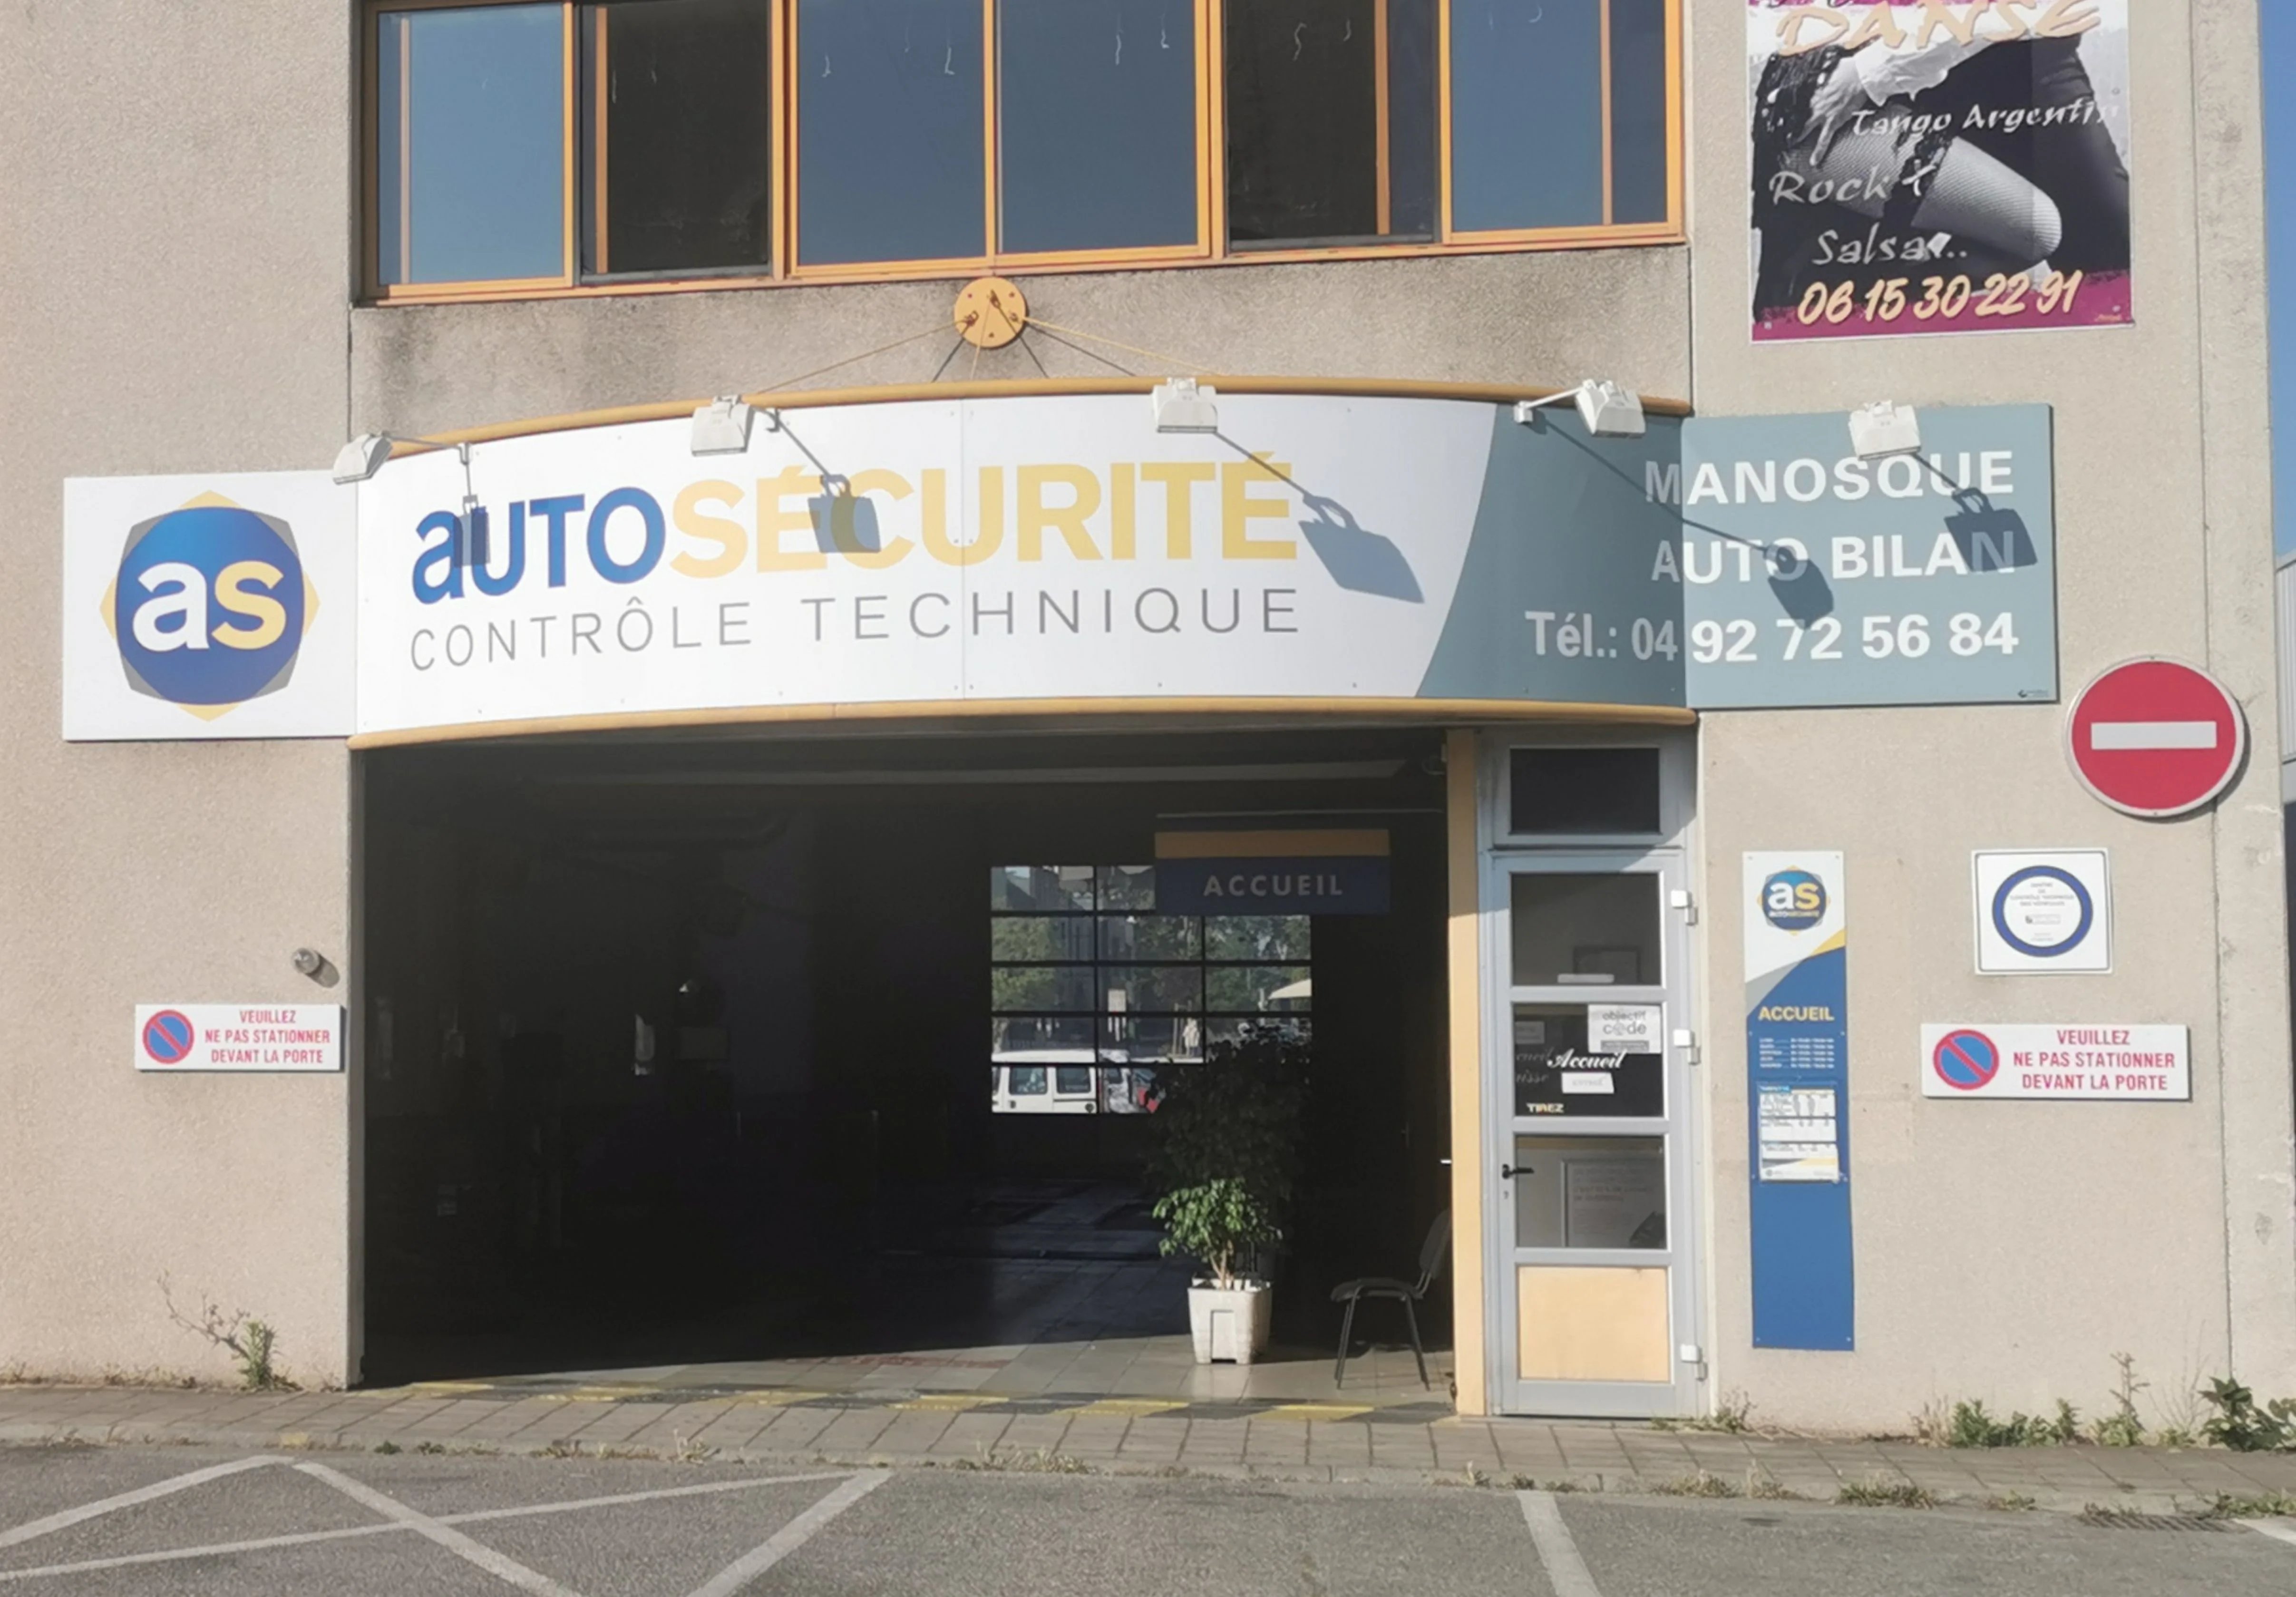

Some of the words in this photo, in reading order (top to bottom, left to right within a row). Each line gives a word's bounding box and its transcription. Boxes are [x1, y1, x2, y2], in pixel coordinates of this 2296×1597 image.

[1776, 0, 2101, 56] DANSE
[1852, 109, 1951, 136] Tango
[1963, 97, 2118, 133] Argentin
[1769, 165, 1889, 205] Rock
[1798, 281, 1854, 324] 06
[1864, 278, 1908, 322] 15
[1914, 274, 1971, 320] 30
[1975, 273, 2027, 317] 22
[2036, 270, 2084, 315] 91
[1645, 450, 2013, 505] MANOSQUE
[1652, 538, 1808, 584] AUTO
[1831, 531, 2014, 580] BILAN
[132, 560, 286, 652] as
[411, 596, 751, 671] CONTRÔLE
[801, 587, 1298, 642] TECHNIQUE
[1632, 618, 1677, 662] 04
[1693, 619, 1757, 663] 92
[1776, 615, 1843, 660] 72
[1862, 614, 1930, 659] 56
[1949, 612, 2019, 656] 84
[1203, 874, 1343, 897] ACCUEIL
[1768, 882, 1820, 910] as
[240, 1010, 296, 1023] VEUILLEZ
[1758, 1006, 1835, 1021] ACCUEIL
[204, 1030, 220, 1043] NE
[224, 1030, 249, 1043] PAS
[253, 1029, 330, 1043] STATIONNER
[2057, 1030, 2130, 1045] VEUILLEZ
[211, 1049, 259, 1063] DEVANT
[264, 1049, 278, 1063] LA
[283, 1049, 323, 1063] PORTE
[1547, 1048, 1628, 1069] Accueil
[2014, 1052, 2033, 1066] NE
[2039, 1052, 2070, 1066] PAS
[2076, 1052, 2175, 1067] STATIONNER
[2022, 1074, 2084, 1090] DEVANT
[2091, 1074, 2109, 1090] LA
[2115, 1074, 2168, 1090] PORTE
[1527, 1102, 1565, 1114] TIREZ
